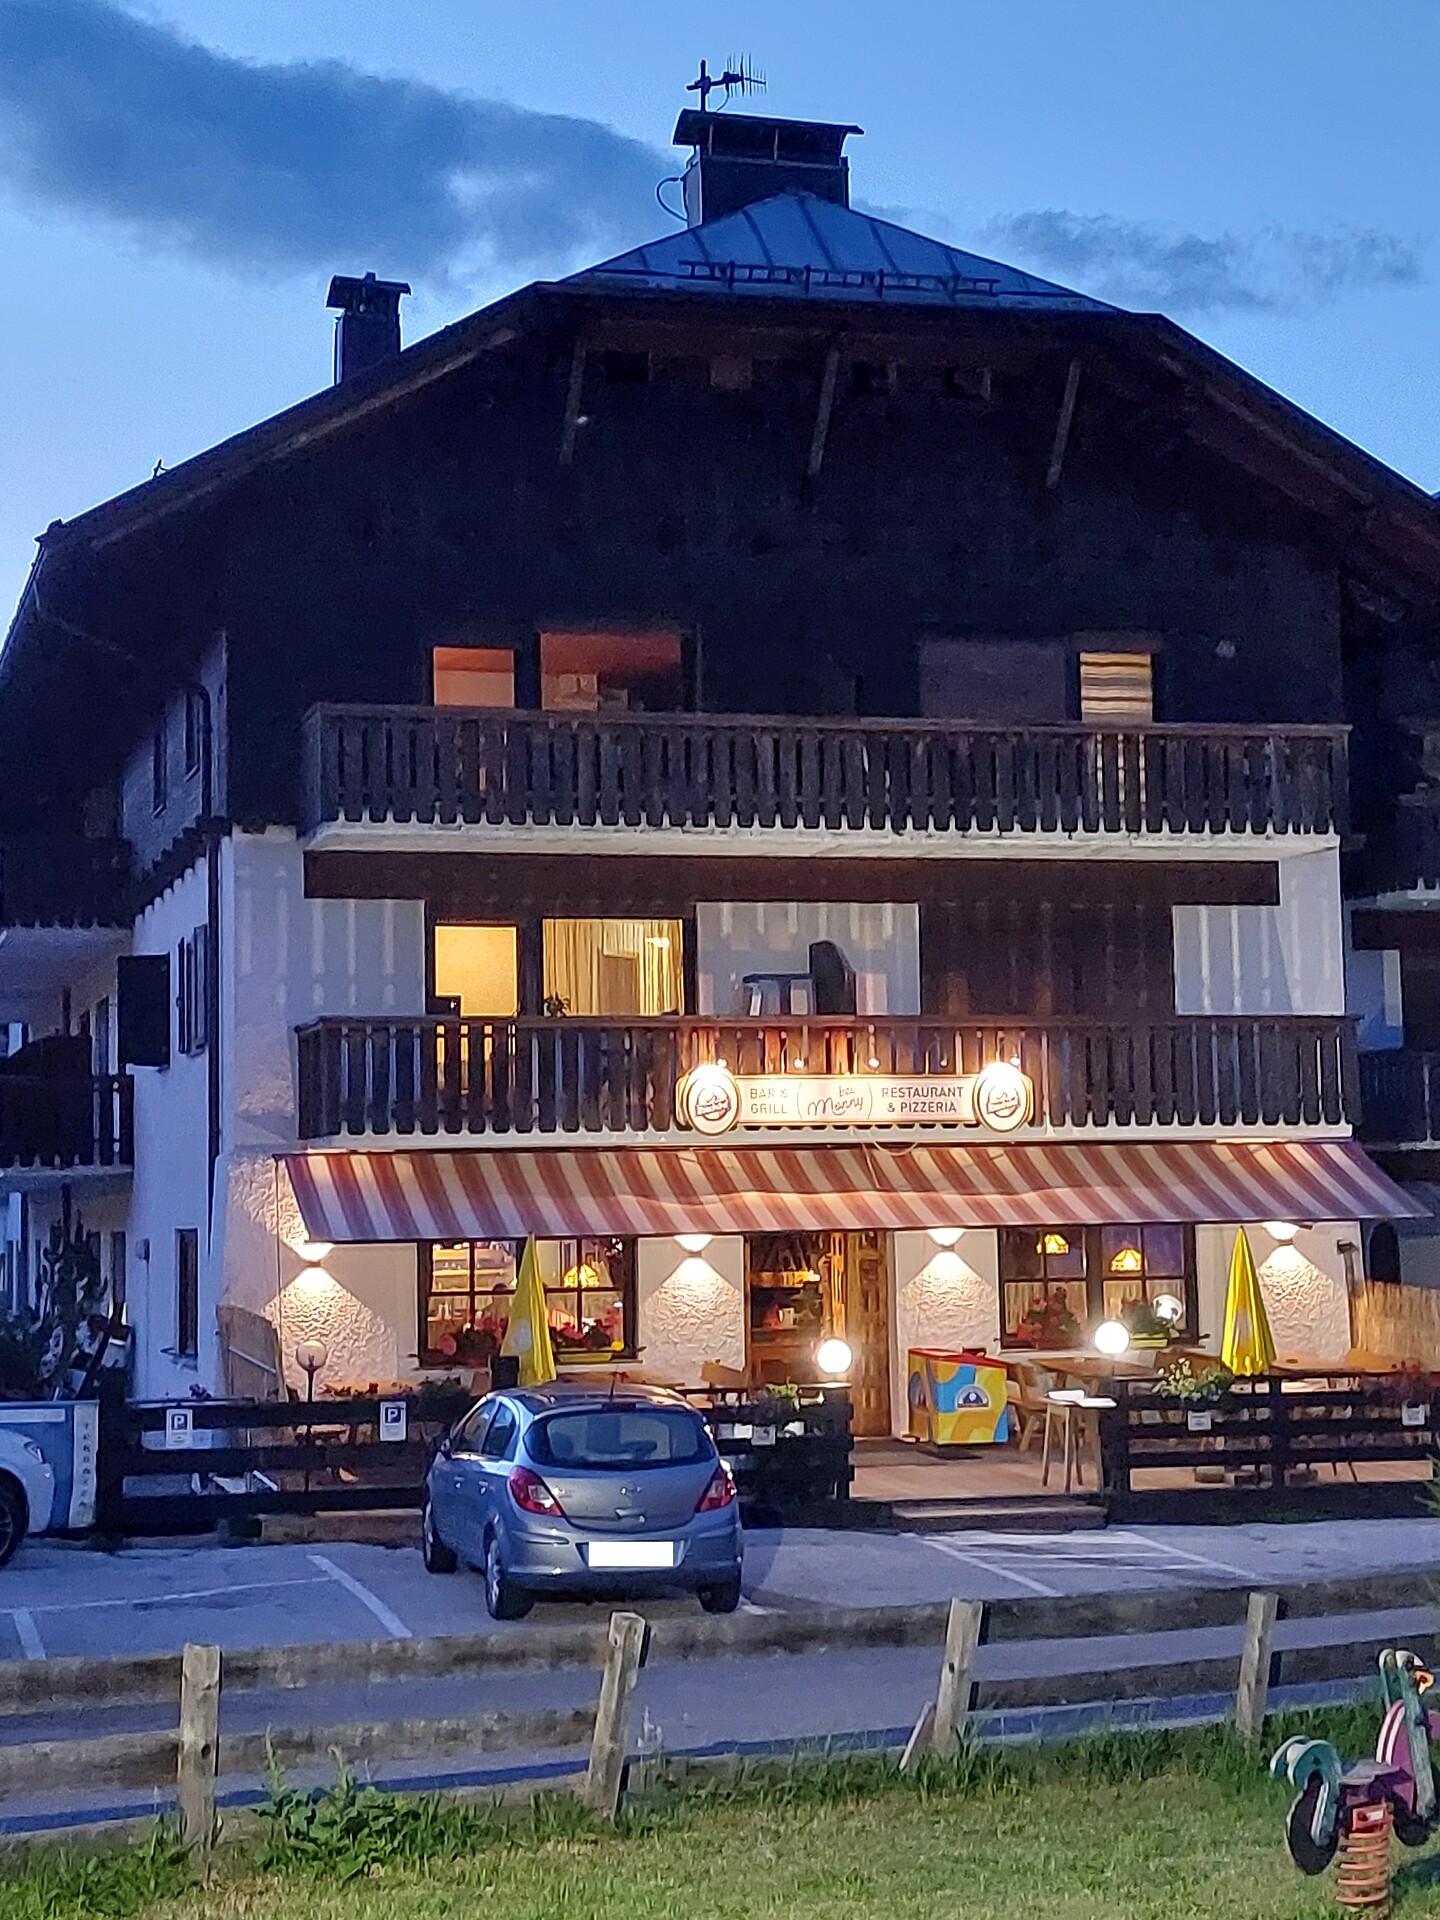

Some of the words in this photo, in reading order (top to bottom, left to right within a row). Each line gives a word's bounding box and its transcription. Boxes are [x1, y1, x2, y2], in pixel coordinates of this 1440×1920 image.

[750, 1088, 775, 1099] BAR
[881, 1086, 964, 1098] RESTAURANT
[750, 1103, 788, 1114] GRILL
[887, 1102, 895, 1113] &
[900, 1101, 957, 1113] PIZZERIA
[387, 1408, 398, 1422] P
[174, 1415, 184, 1429] P
